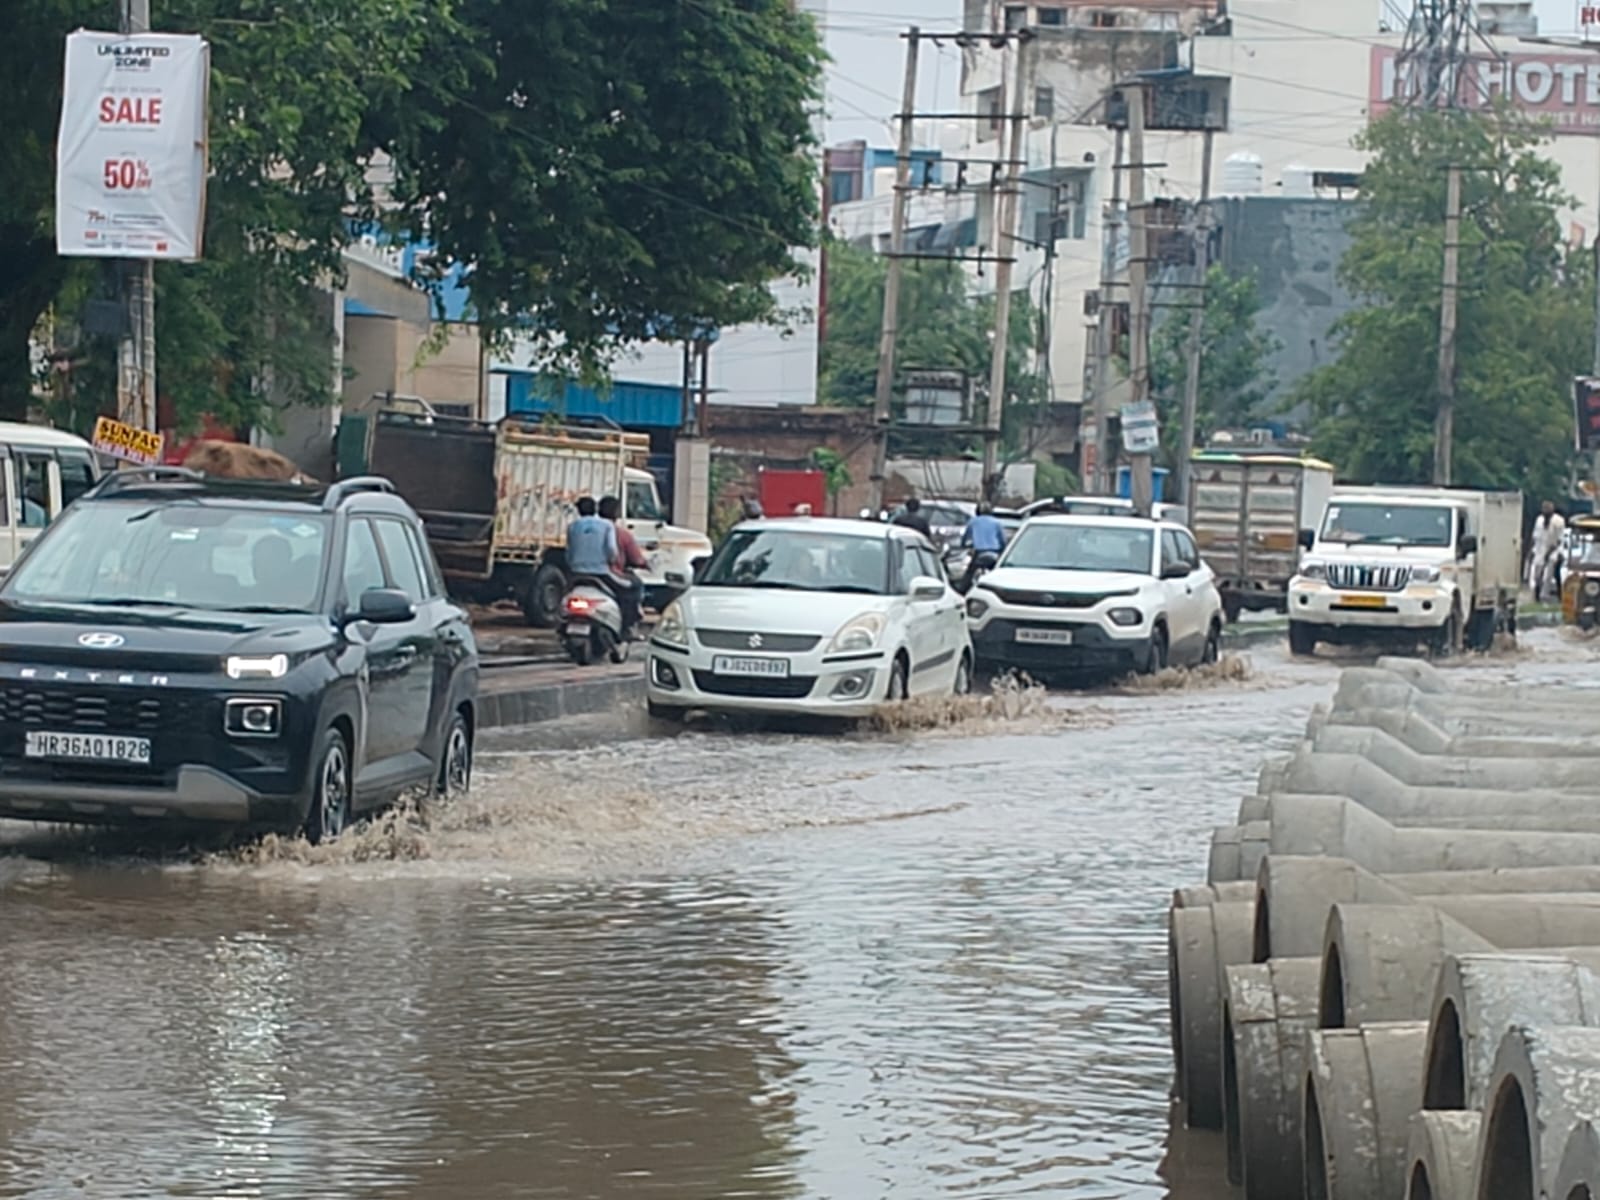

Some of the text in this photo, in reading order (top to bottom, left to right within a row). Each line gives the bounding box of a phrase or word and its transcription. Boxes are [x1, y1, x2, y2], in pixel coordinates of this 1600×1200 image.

[1581, 7, 1600, 25] H
[97, 45, 170, 57] UNLIMITED
[115, 57, 151, 67] ZONE
[99, 96, 162, 123] SALE
[104, 159, 149, 189] 50%
[20, 668, 168, 685] EXTER
